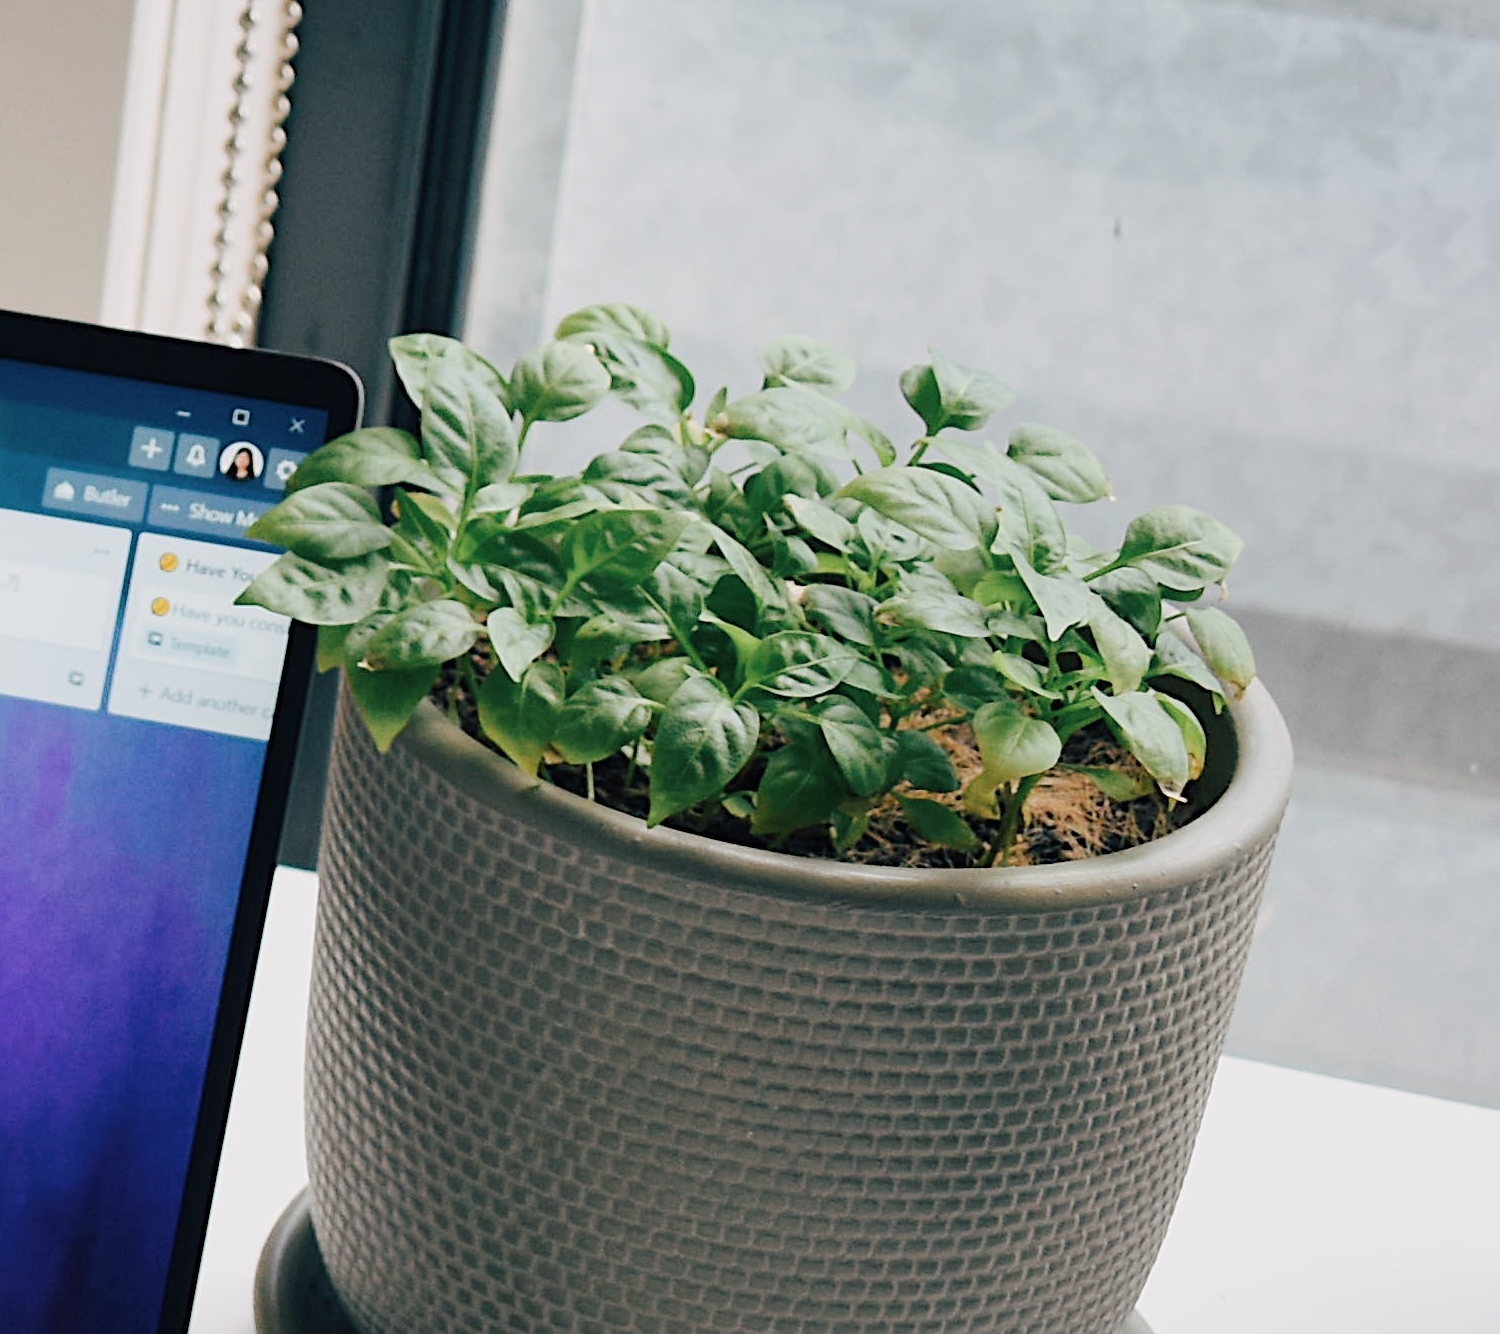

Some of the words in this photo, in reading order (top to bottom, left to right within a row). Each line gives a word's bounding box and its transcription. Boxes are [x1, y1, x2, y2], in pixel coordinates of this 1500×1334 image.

[83, 484, 133, 508] Butler
[187, 501, 235, 526] Show
[185, 557, 228, 580] Have
